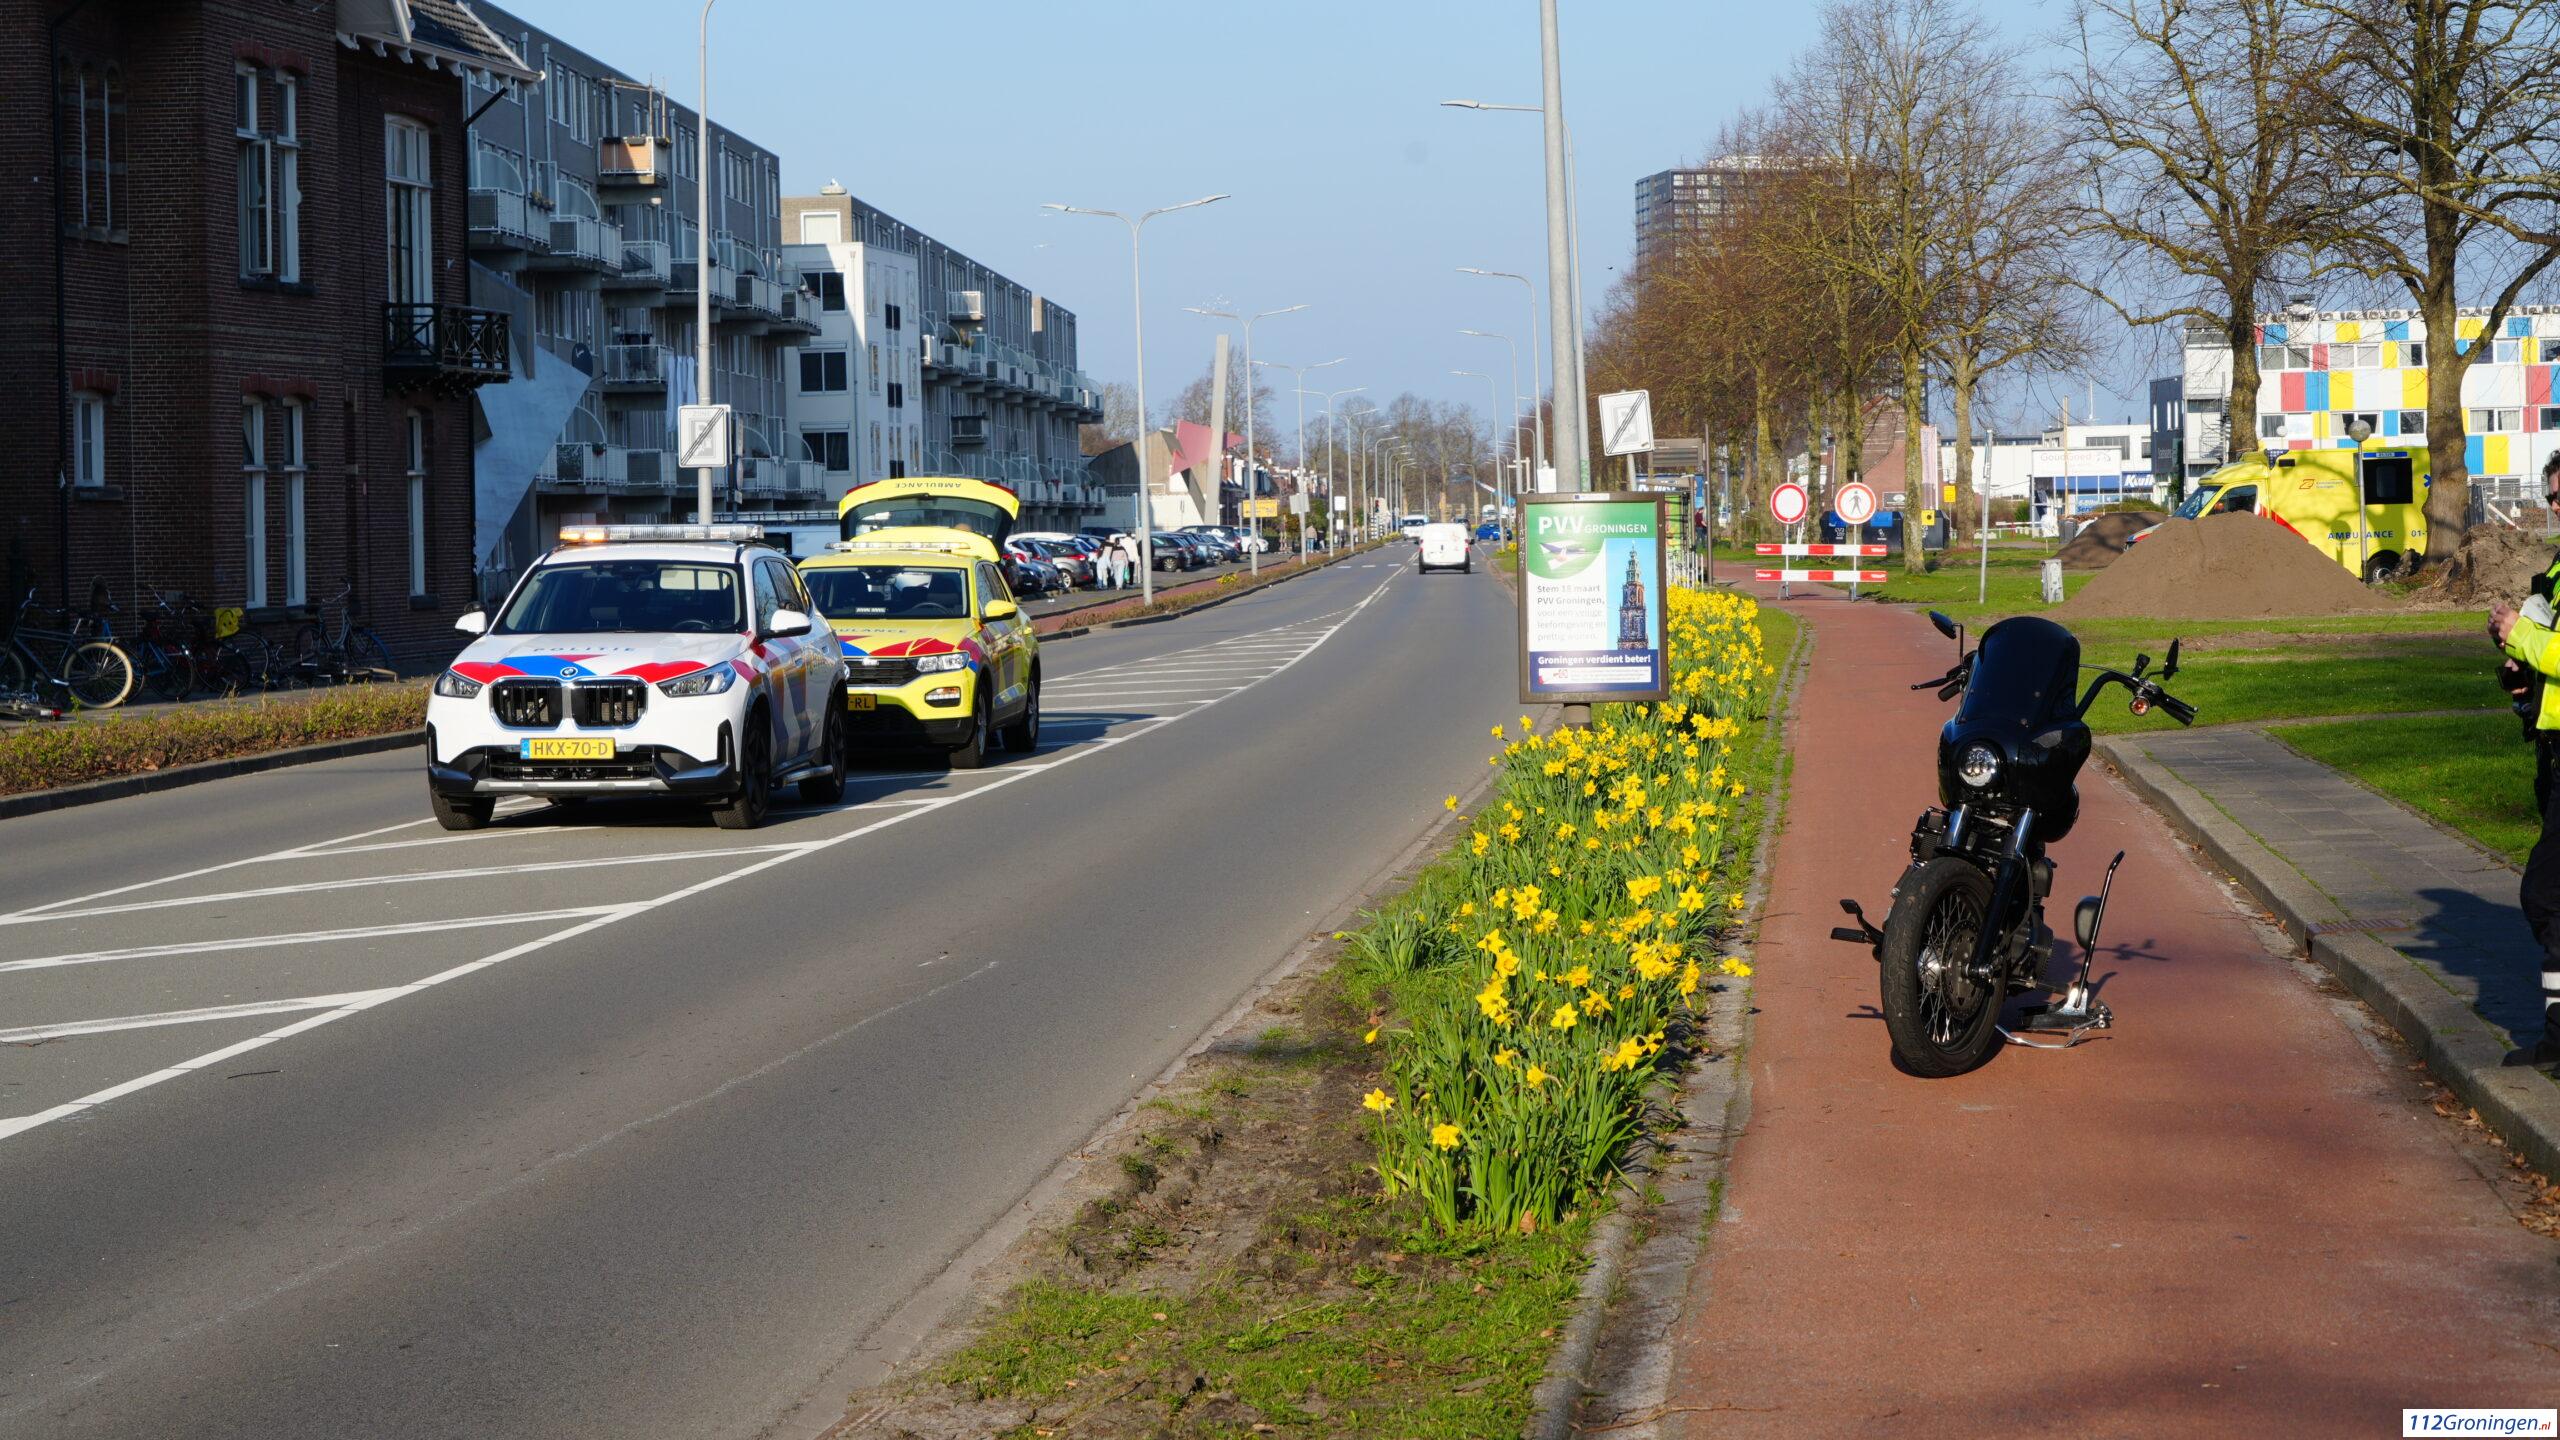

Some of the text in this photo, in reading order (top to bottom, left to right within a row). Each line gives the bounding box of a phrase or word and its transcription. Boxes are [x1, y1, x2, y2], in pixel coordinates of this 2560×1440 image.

[1538, 515, 1648, 535] PVV GRONINGEN
[2327, 530, 2394, 540] AMBUANCE
[1537, 584, 1560, 593] Stem
[1573, 584, 1601, 593] maart
[1537, 597, 1554, 605] PVV
[1538, 653, 1651, 666] Groningen verdient beter!
[534, 742, 608, 756] HKX-70-D
